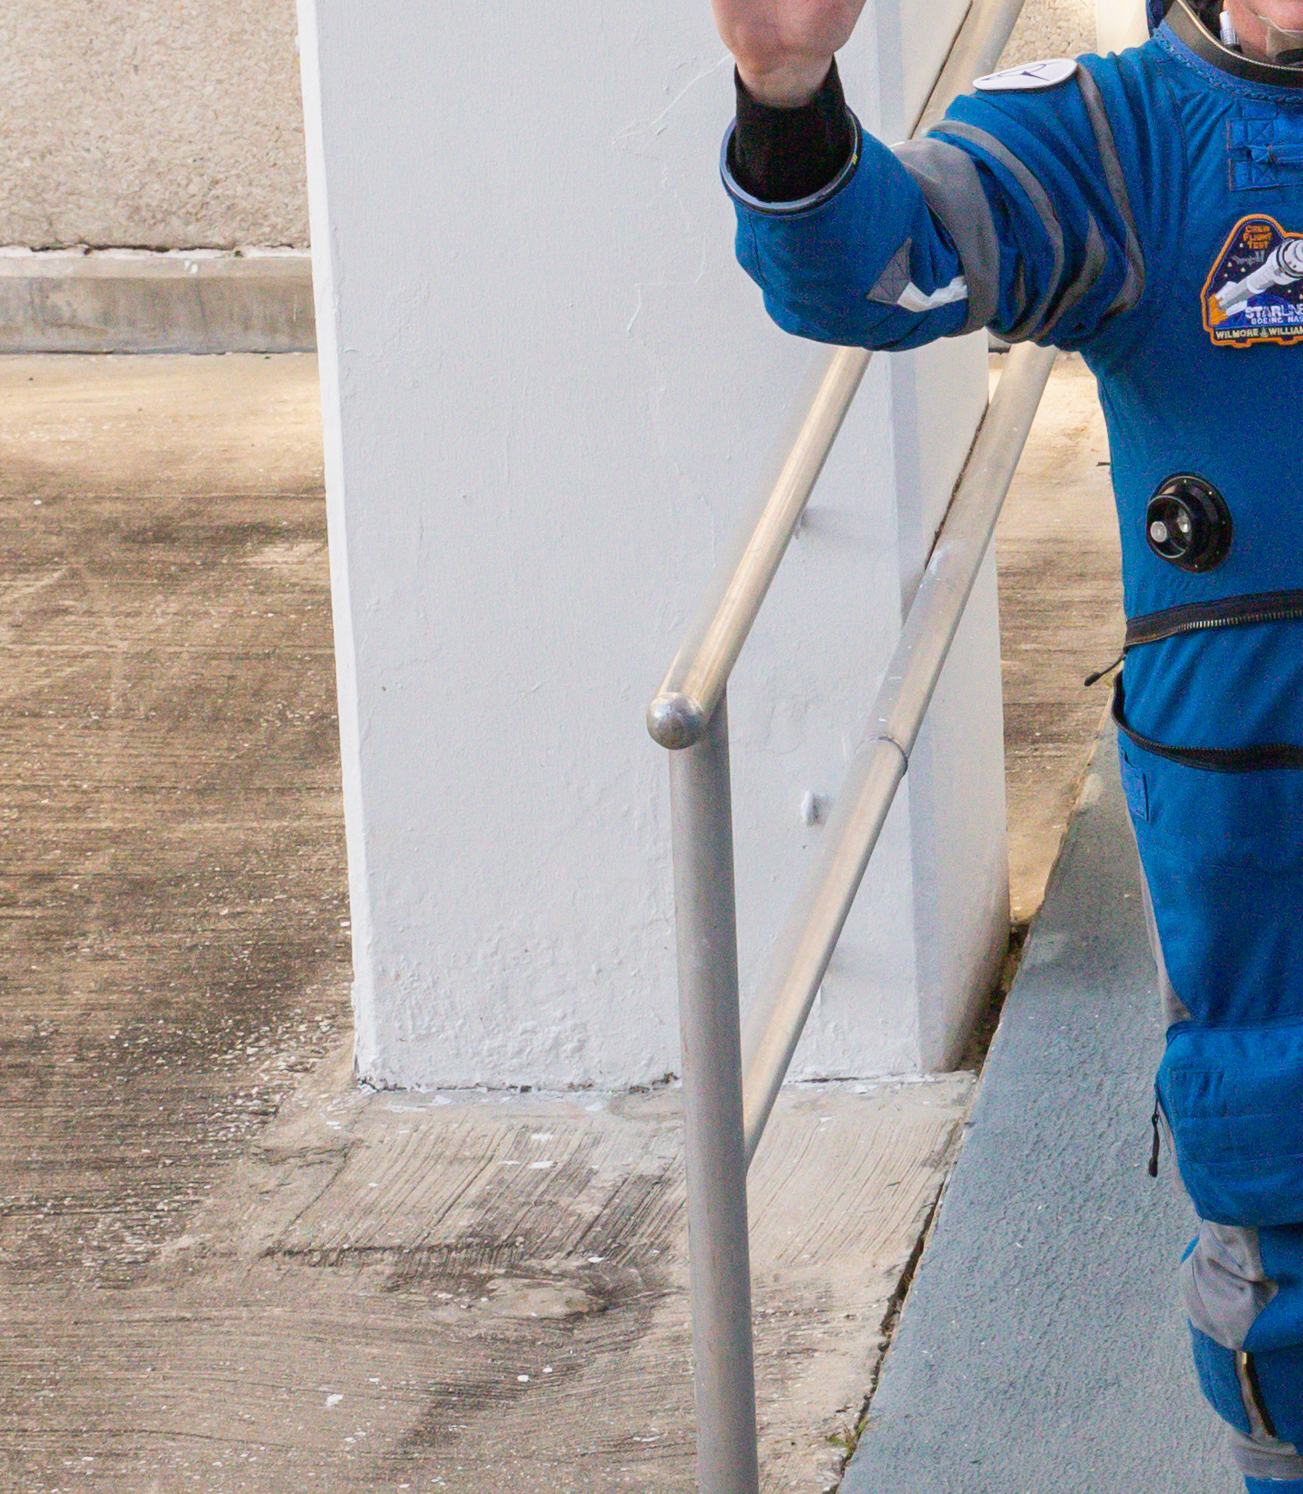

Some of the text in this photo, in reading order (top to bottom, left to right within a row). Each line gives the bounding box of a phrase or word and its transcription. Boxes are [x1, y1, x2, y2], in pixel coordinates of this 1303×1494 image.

[1248, 241, 1268, 249] TEST
[1251, 316, 1284, 325] BOEING
[1216, 328, 1258, 339] WILMORE
